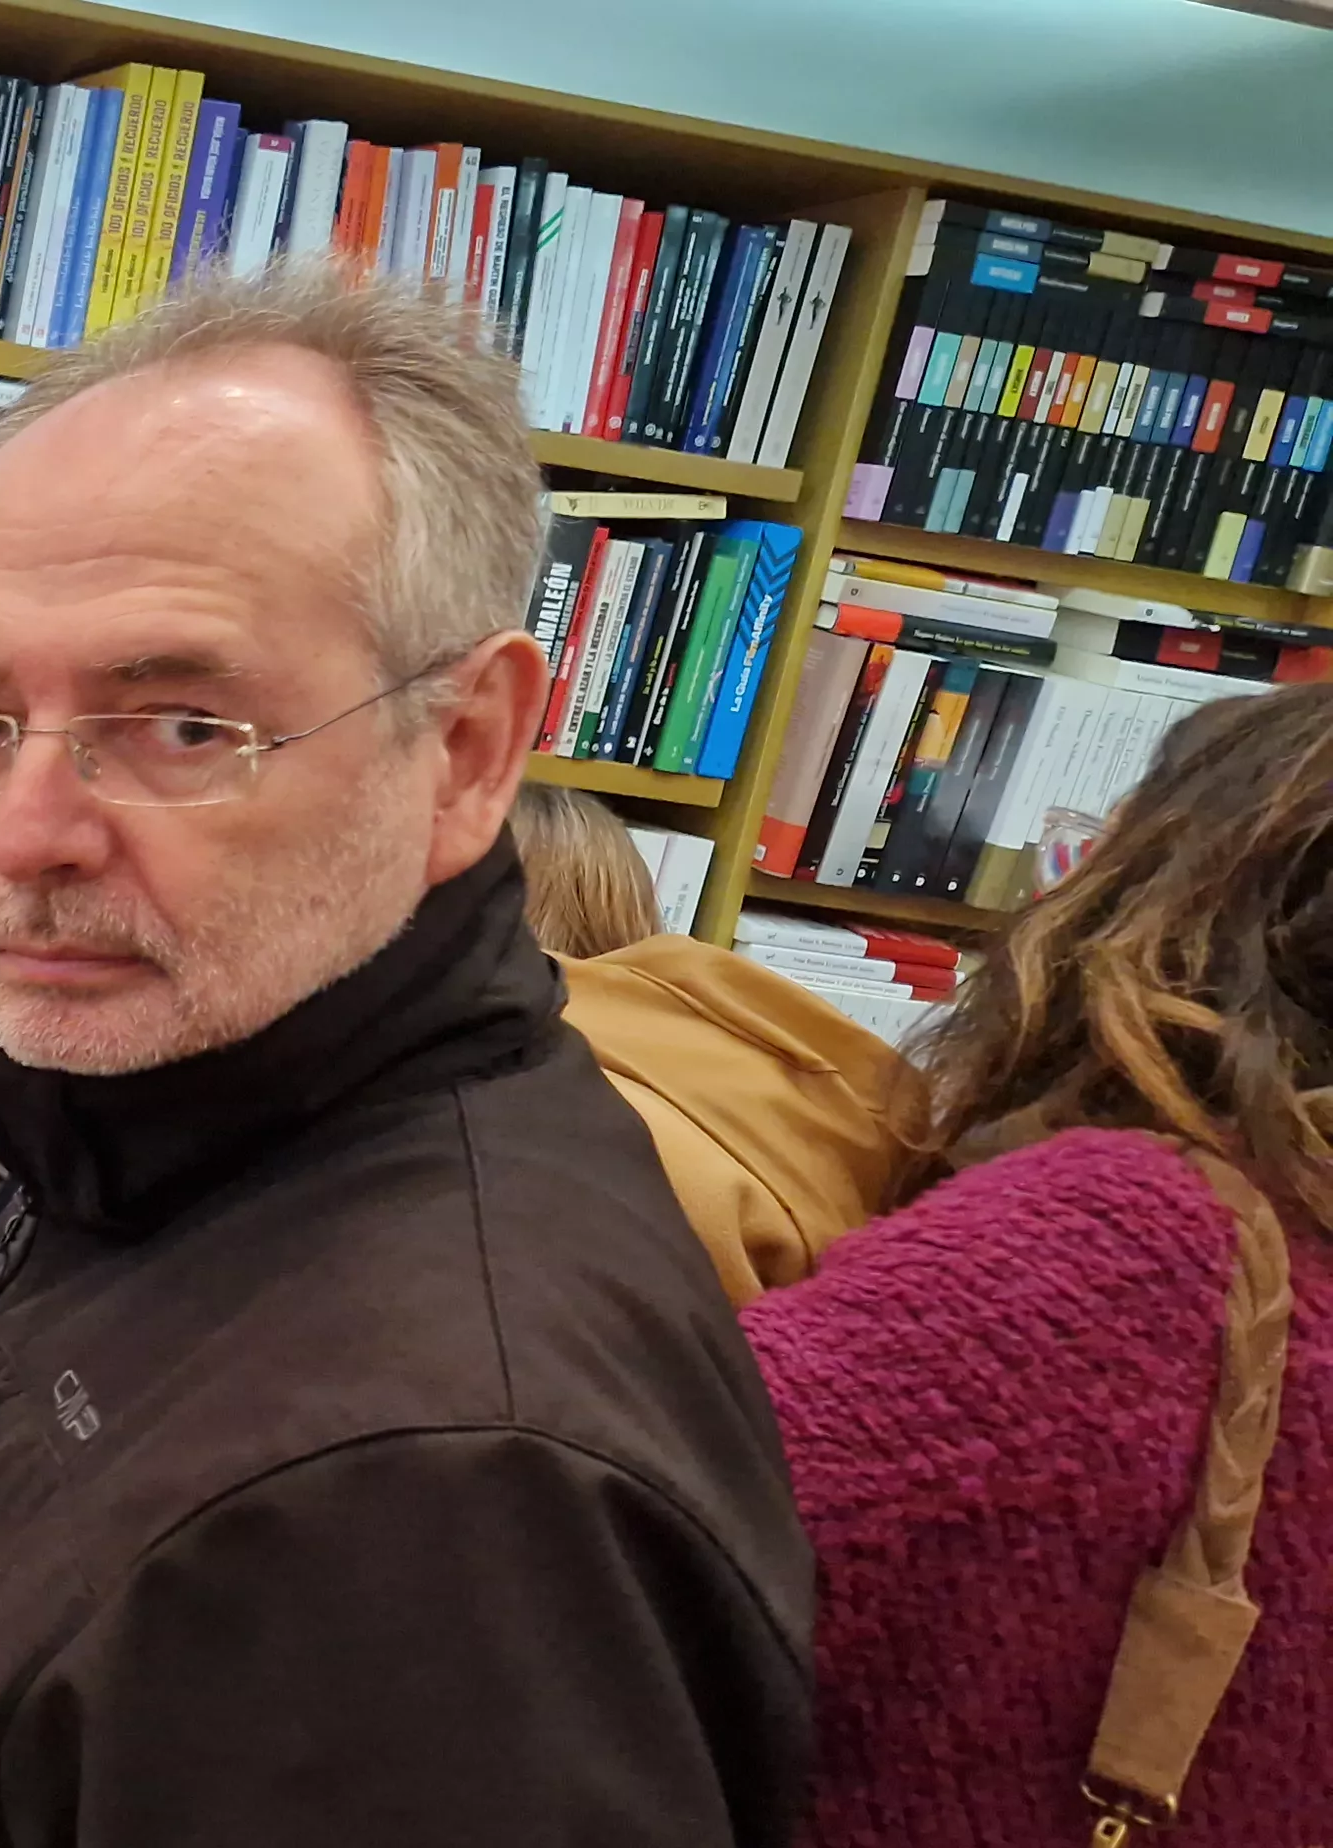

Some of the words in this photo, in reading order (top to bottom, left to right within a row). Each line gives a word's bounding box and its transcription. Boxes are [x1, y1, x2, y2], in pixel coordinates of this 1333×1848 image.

[120, 92, 143, 154] RECUERDO
[144, 98, 167, 159] RECUERDO
[172, 99, 195, 161] RECUERDO
[111, 165, 131, 212] OFICIOS
[135, 170, 155, 215] OFICIOS
[162, 172, 182, 218] OFICIOS
[108, 213, 123, 235] 100
[131, 218, 147, 238] 100
[158, 220, 173, 241] 100
[534, 562, 573, 666] AMALEÓN
[589, 600, 609, 650] NECESIDAD
[586, 649, 597, 663] LA
[575, 692, 586, 704] EL
[578, 669, 591, 691] AZAR
[734, 665, 752, 697] Guía
[730, 696, 742, 712] La
